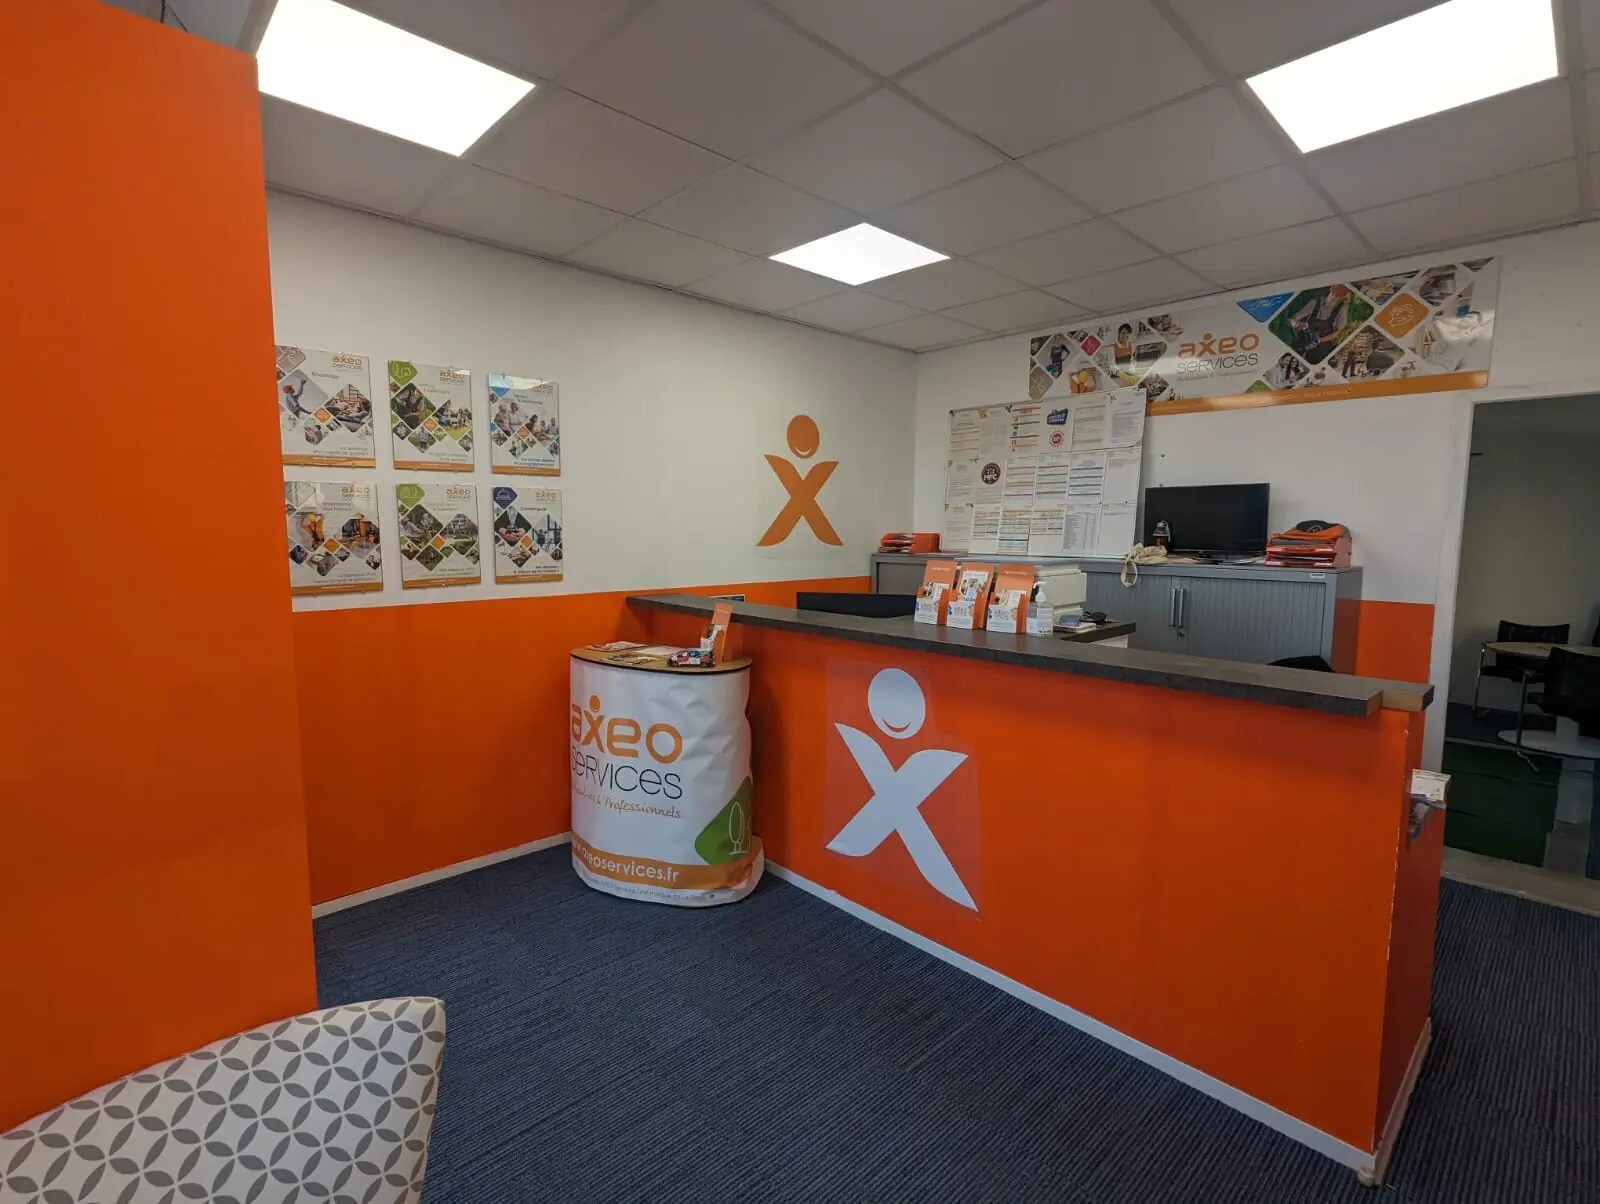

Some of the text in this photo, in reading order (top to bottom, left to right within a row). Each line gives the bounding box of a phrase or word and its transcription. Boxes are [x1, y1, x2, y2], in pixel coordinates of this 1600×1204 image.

[1178, 332, 1260, 357] axeo
[571, 695, 683, 764] axeo
[604, 796, 681, 819] Professionnels
